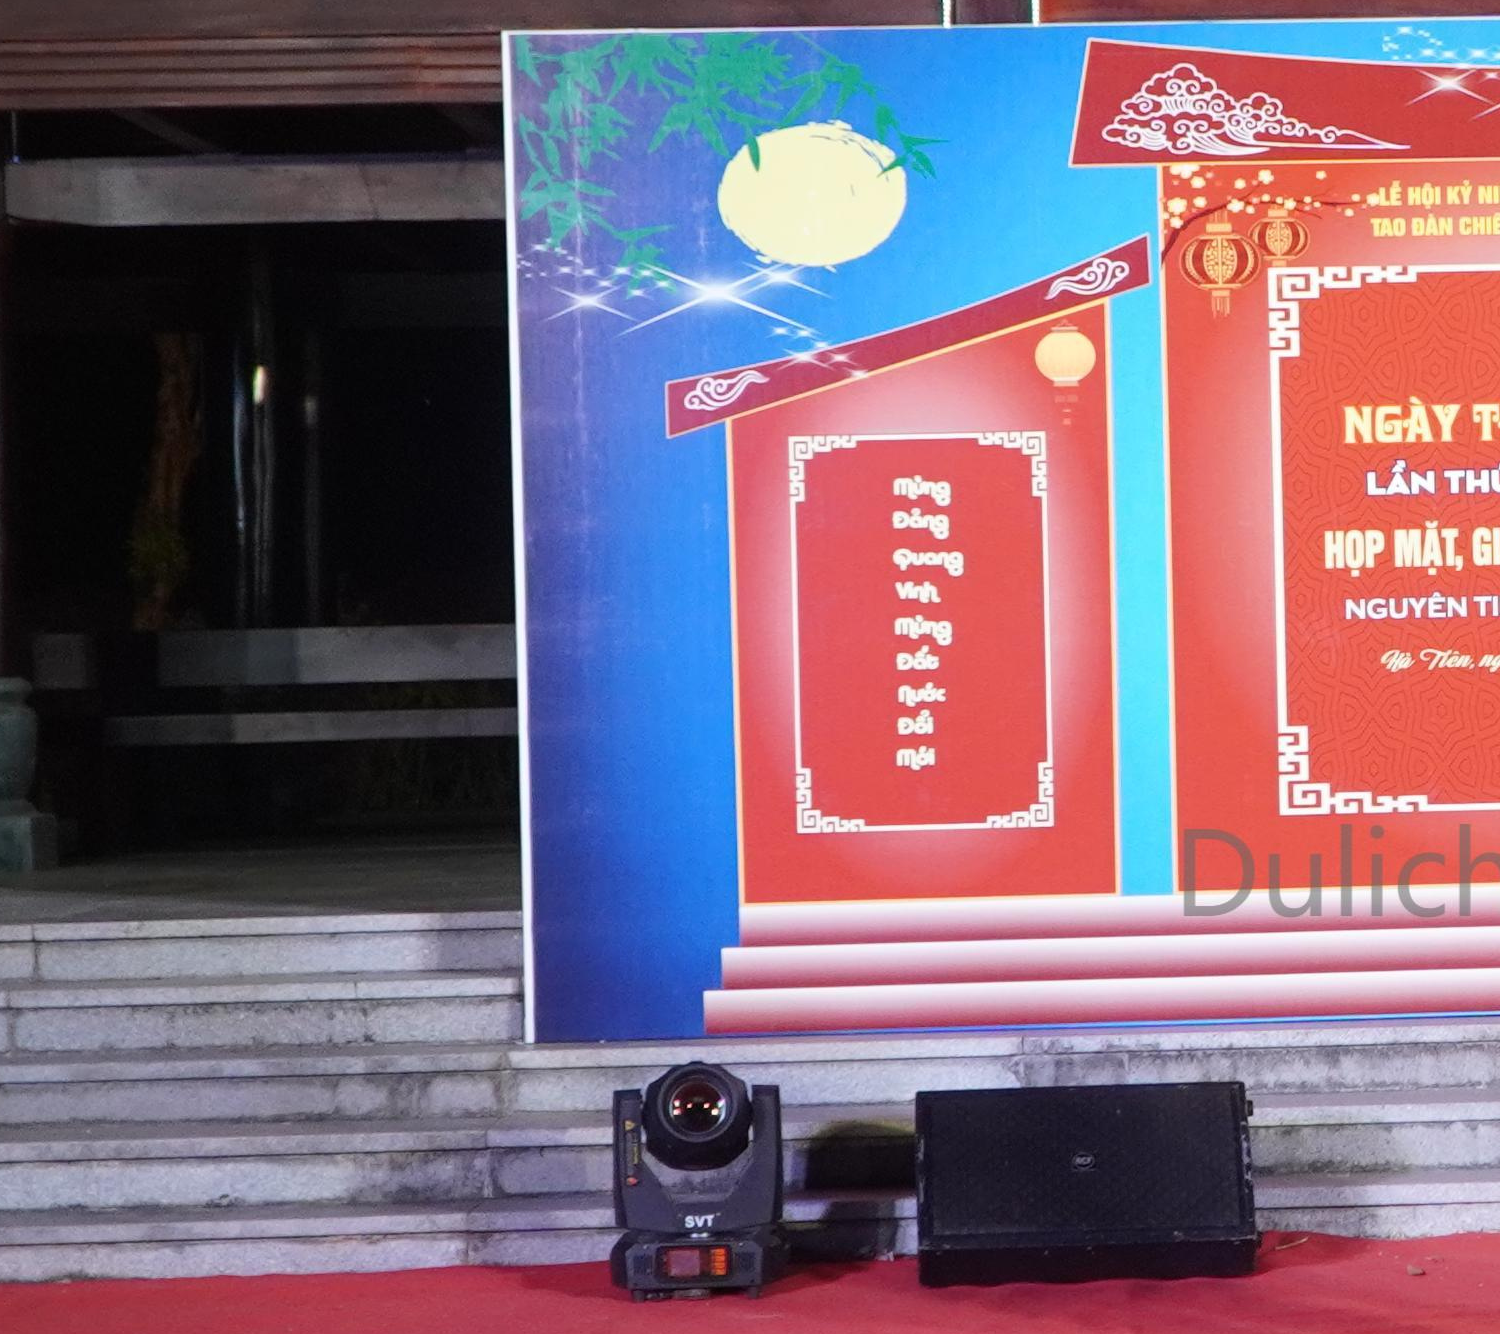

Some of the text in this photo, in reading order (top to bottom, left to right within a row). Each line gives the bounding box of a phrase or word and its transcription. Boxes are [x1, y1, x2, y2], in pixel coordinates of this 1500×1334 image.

[1408, 183, 1441, 209] HỘI
[1371, 217, 1406, 237] TAO
[1411, 213, 1453, 236] ĐÀN
[1343, 396, 1461, 444] NGÀY
[1366, 459, 1436, 496] LẦN
[893, 548, 964, 577] Quang
[1324, 528, 1385, 577] HỌP
[1393, 520, 1464, 575] MẶT,
[1344, 591, 1468, 620] NGUYÊN
